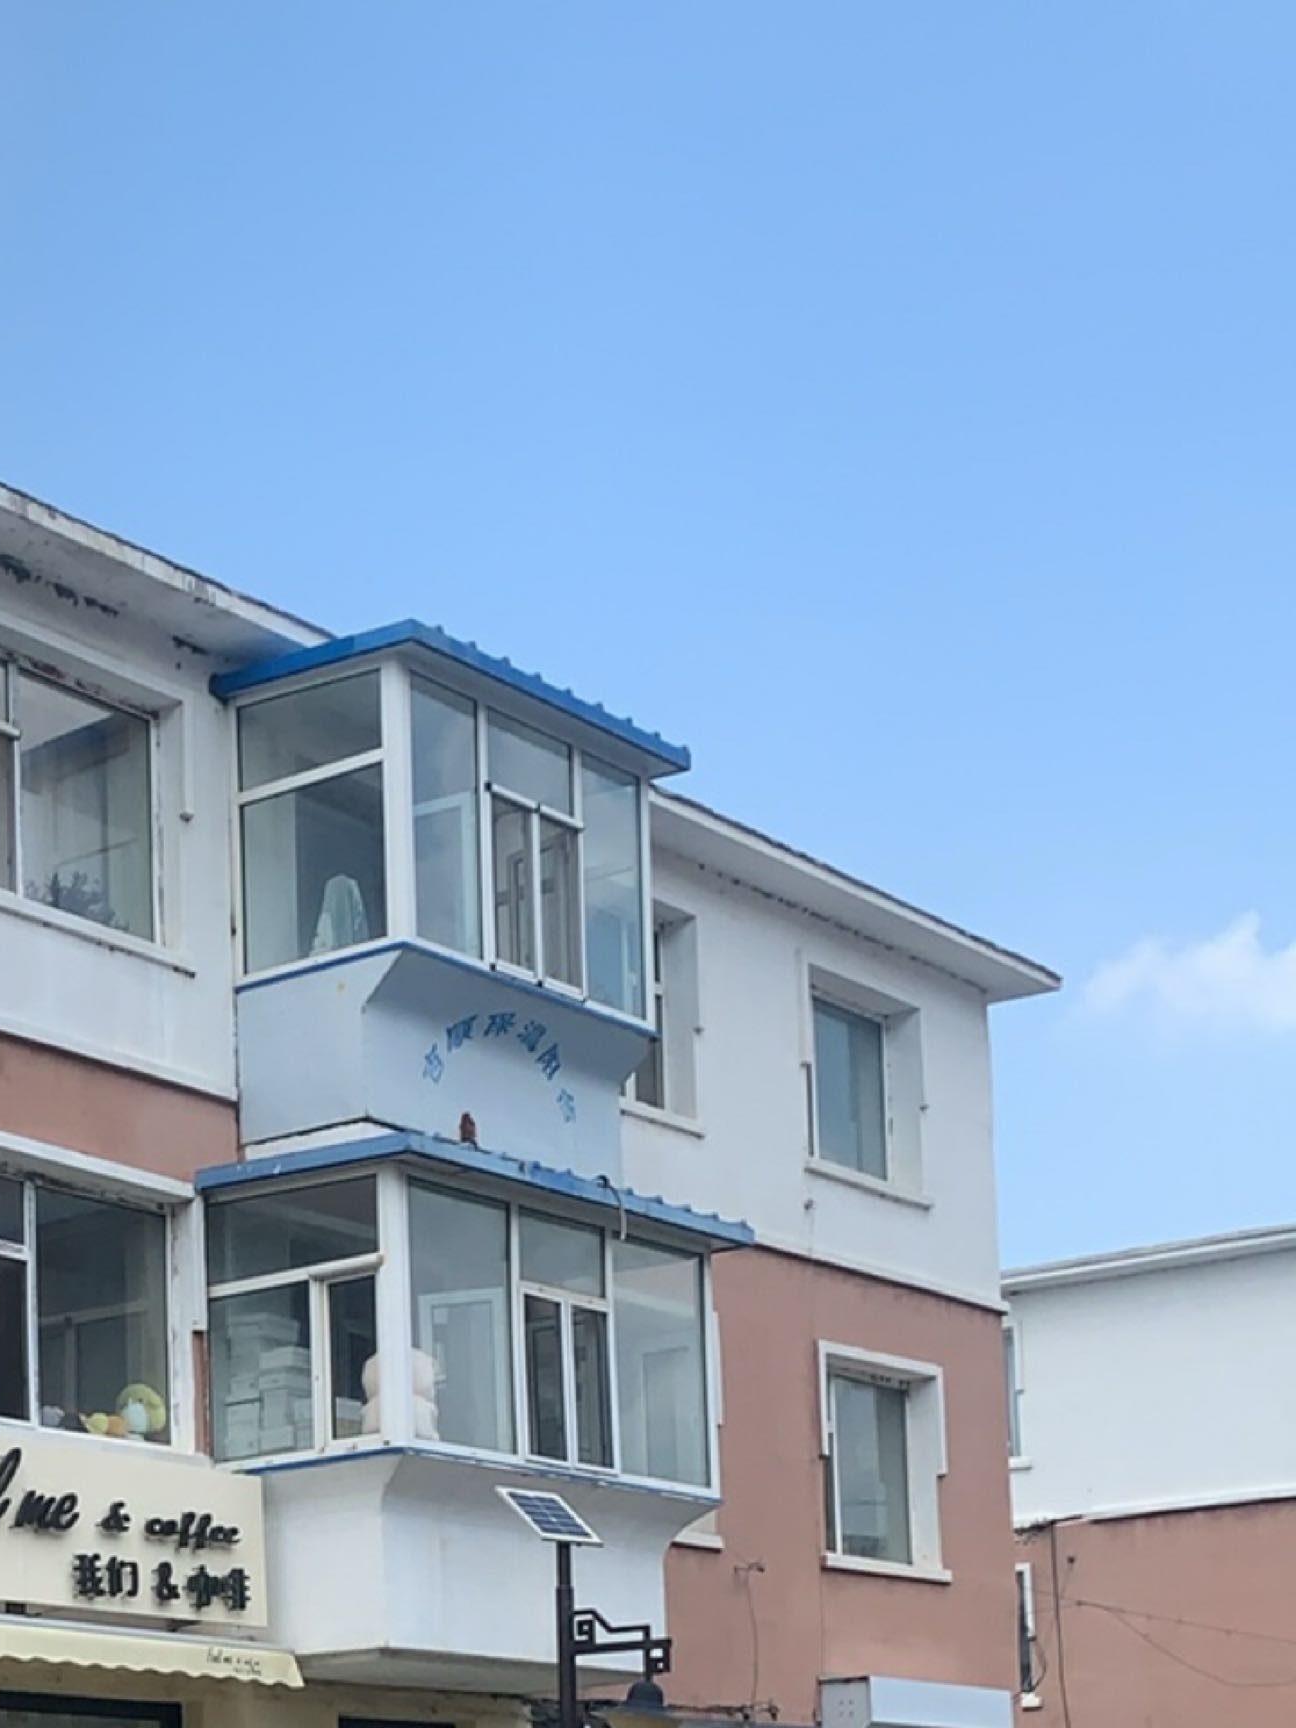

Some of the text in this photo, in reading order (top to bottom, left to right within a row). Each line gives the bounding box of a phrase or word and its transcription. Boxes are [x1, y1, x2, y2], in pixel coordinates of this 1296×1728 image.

[10, 1489, 81, 1531] me
[96, 1501, 132, 1534] &
[145, 1511, 241, 1551] coffee
[72, 1553, 251, 1612] 我们 & 咖啡
